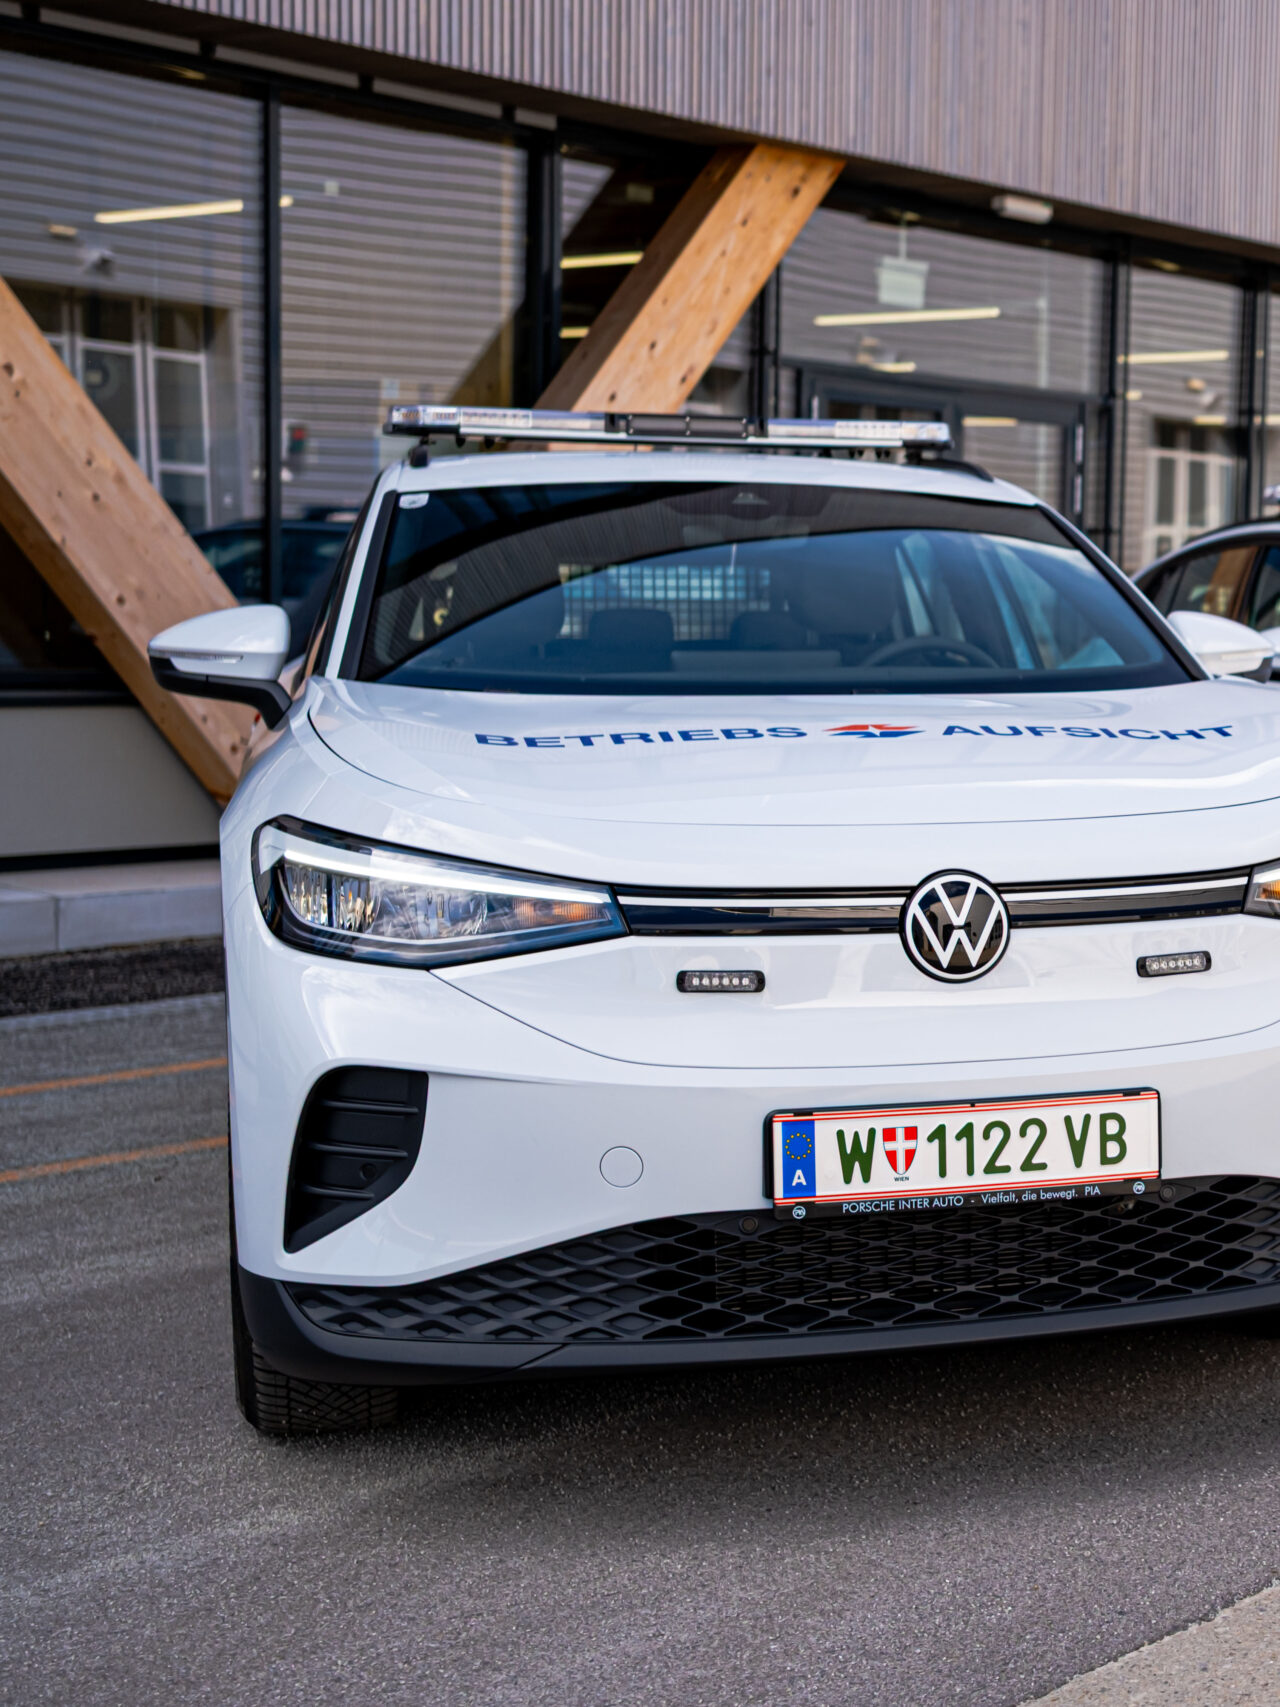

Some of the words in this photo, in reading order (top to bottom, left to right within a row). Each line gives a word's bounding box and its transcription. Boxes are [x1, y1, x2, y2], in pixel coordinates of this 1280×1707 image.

[474, 726, 808, 749] BETRIEBS
[942, 724, 1234, 741] AUFSICHT
[904, 871, 1009, 981] VW
[836, 1126, 876, 1185] W
[926, 1117, 1048, 1179] 1122
[1063, 1112, 1128, 1169] VB
[791, 1169, 807, 1187] A
[893, 1175, 910, 1183] WIEN
[842, 1200, 896, 1214] PORSCHE
[898, 1198, 931, 1211] INTER
[932, 1195, 964, 1208] AUTO
[981, 1191, 1019, 1205] Vielfalt,
[1021, 1189, 1037, 1201] die
[1040, 1187, 1078, 1201] bewegt.
[1084, 1185, 1101, 1196] PIA
